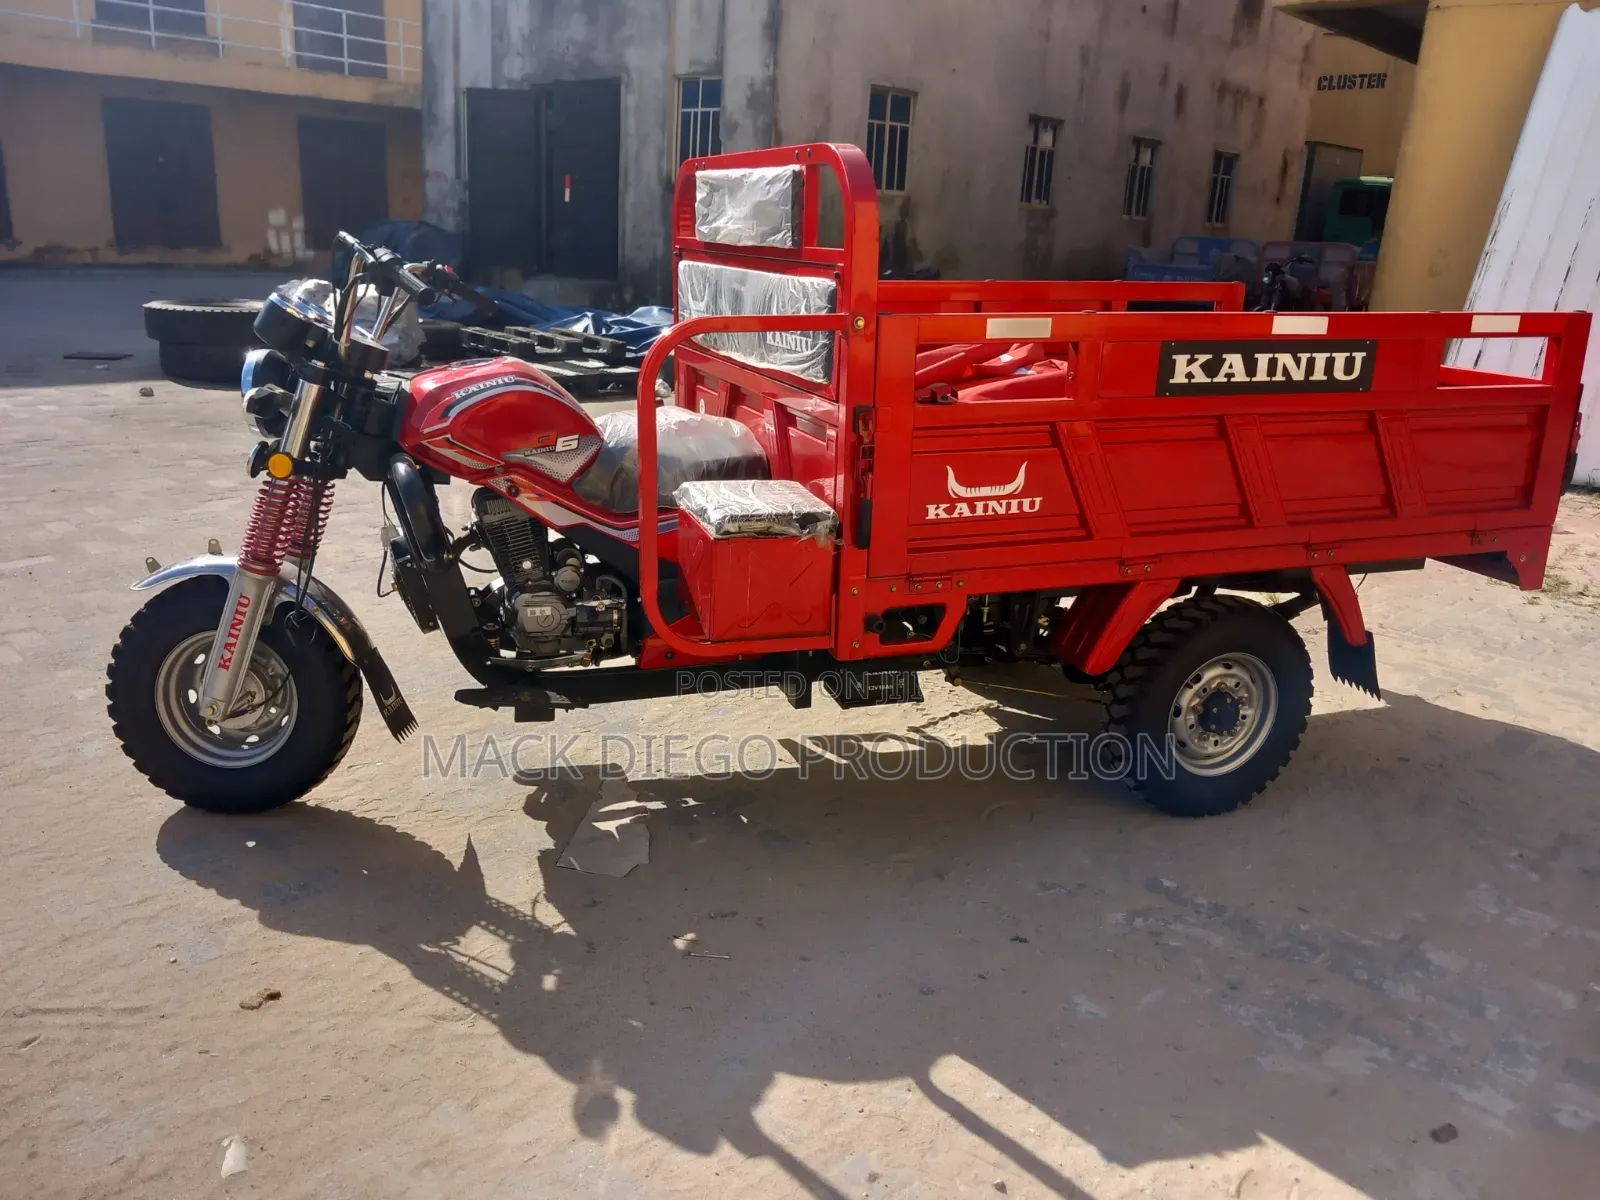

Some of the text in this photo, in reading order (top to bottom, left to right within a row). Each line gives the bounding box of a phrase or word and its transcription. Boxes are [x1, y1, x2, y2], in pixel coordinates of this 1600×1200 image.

[1317, 73, 1388, 90] CLUSTER
[1169, 352, 1367, 384] KAINIU
[451, 375, 516, 399] KAINIU
[925, 497, 1043, 520] KAINIU
[218, 592, 252, 672] KAINIU
